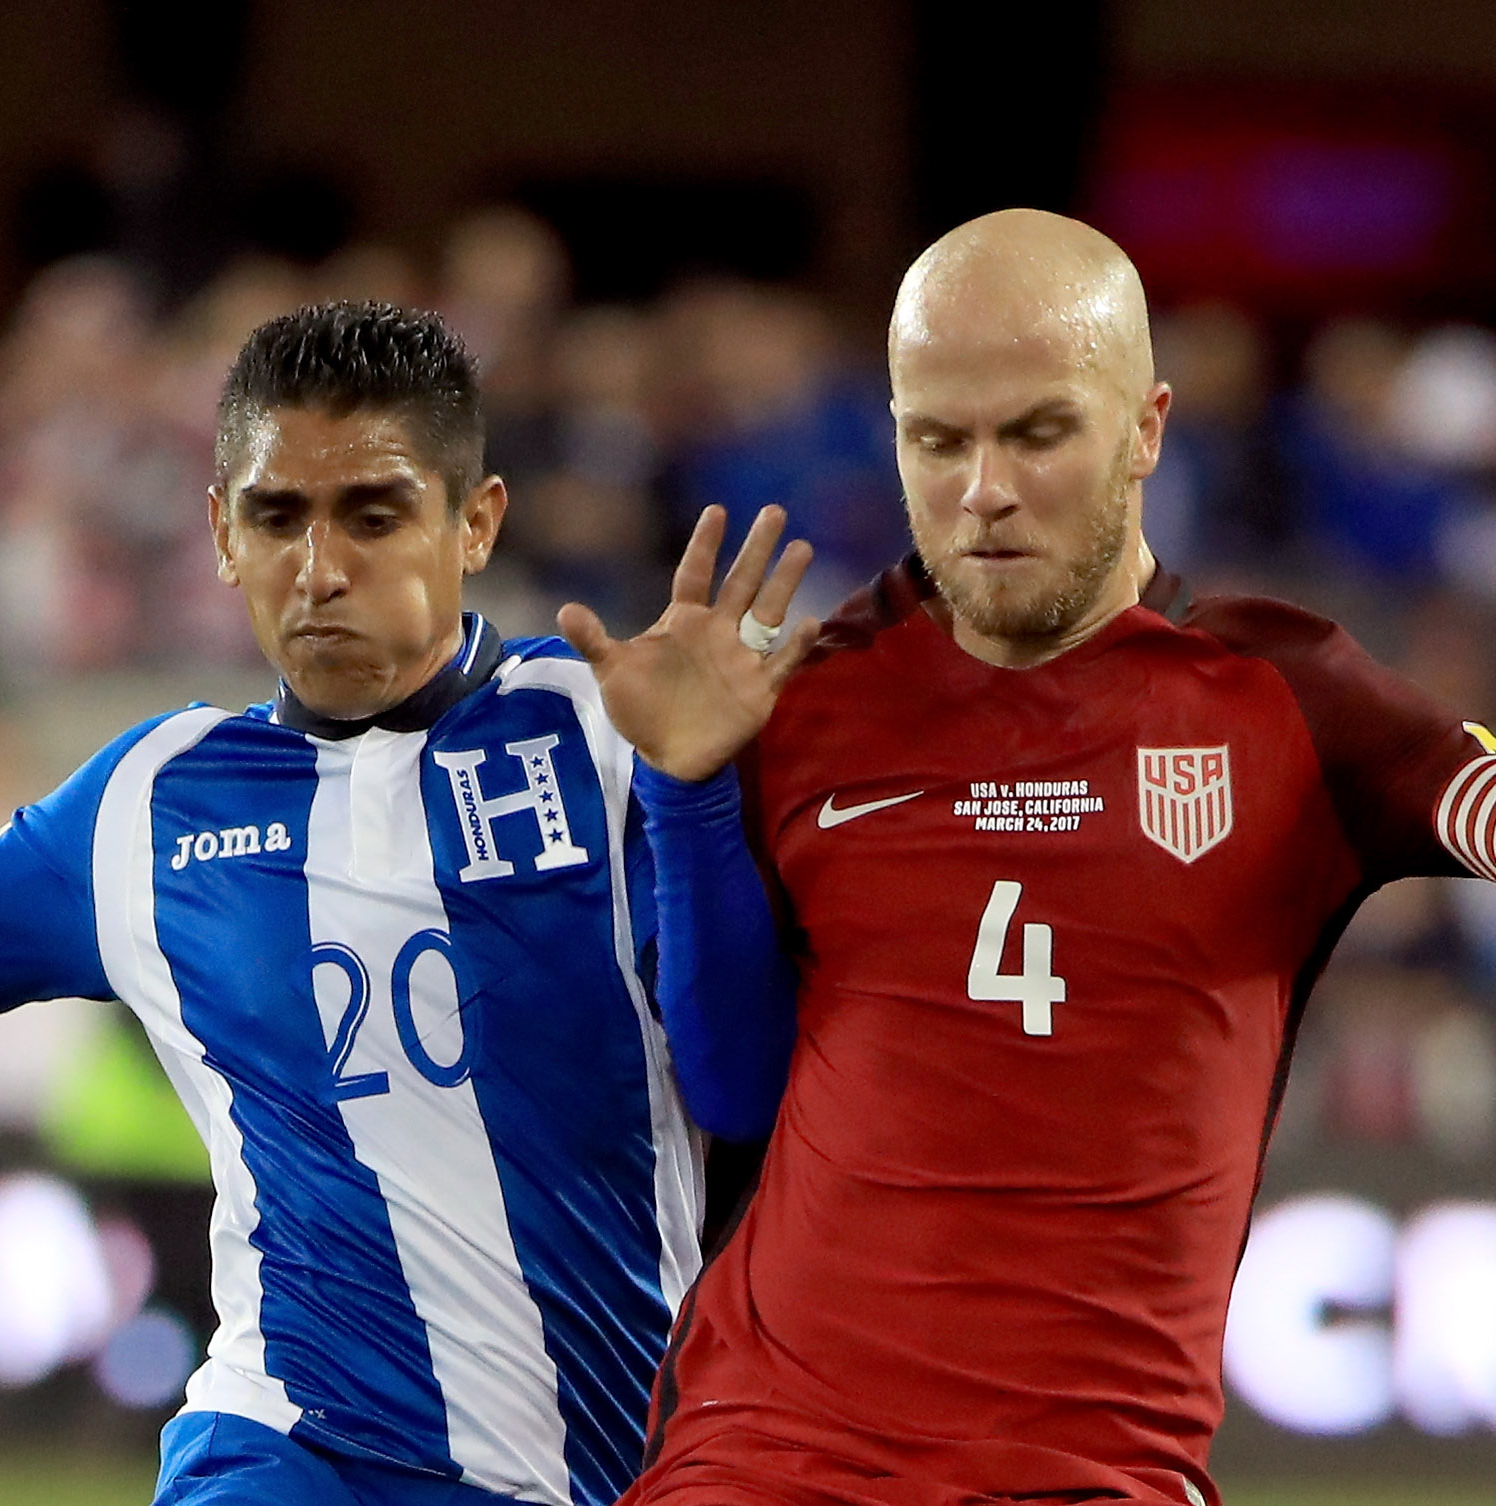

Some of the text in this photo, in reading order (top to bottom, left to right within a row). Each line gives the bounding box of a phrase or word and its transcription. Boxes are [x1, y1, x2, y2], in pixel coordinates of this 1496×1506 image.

[953, 800, 982, 816] SAN
[1024, 797, 1104, 815] CALIFORNIA
[970, 782, 998, 798] USA
[1015, 780, 1088, 797] HONDURAS
[1144, 753, 1223, 796] USA
[433, 734, 589, 883] H
[457, 769, 489, 861] HONDURAS
[975, 817, 1024, 831] MARCH
[968, 880, 1066, 1036] 4
[309, 927, 475, 1103] 20
